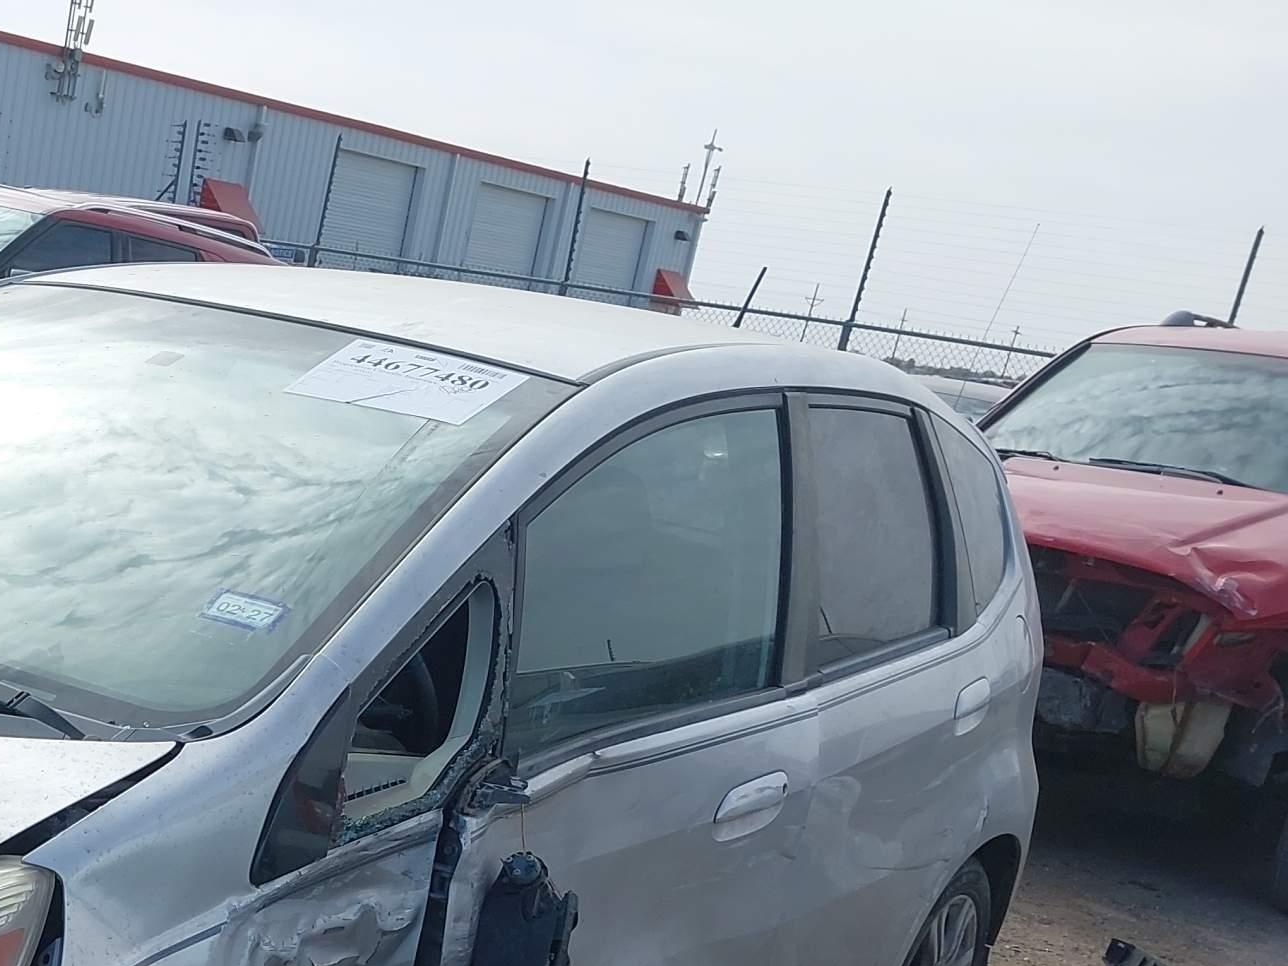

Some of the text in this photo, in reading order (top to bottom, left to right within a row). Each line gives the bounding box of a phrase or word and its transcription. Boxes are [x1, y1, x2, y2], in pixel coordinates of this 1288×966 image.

[350, 354, 490, 390] 44677480
[216, 602, 274, 622] 02 27
